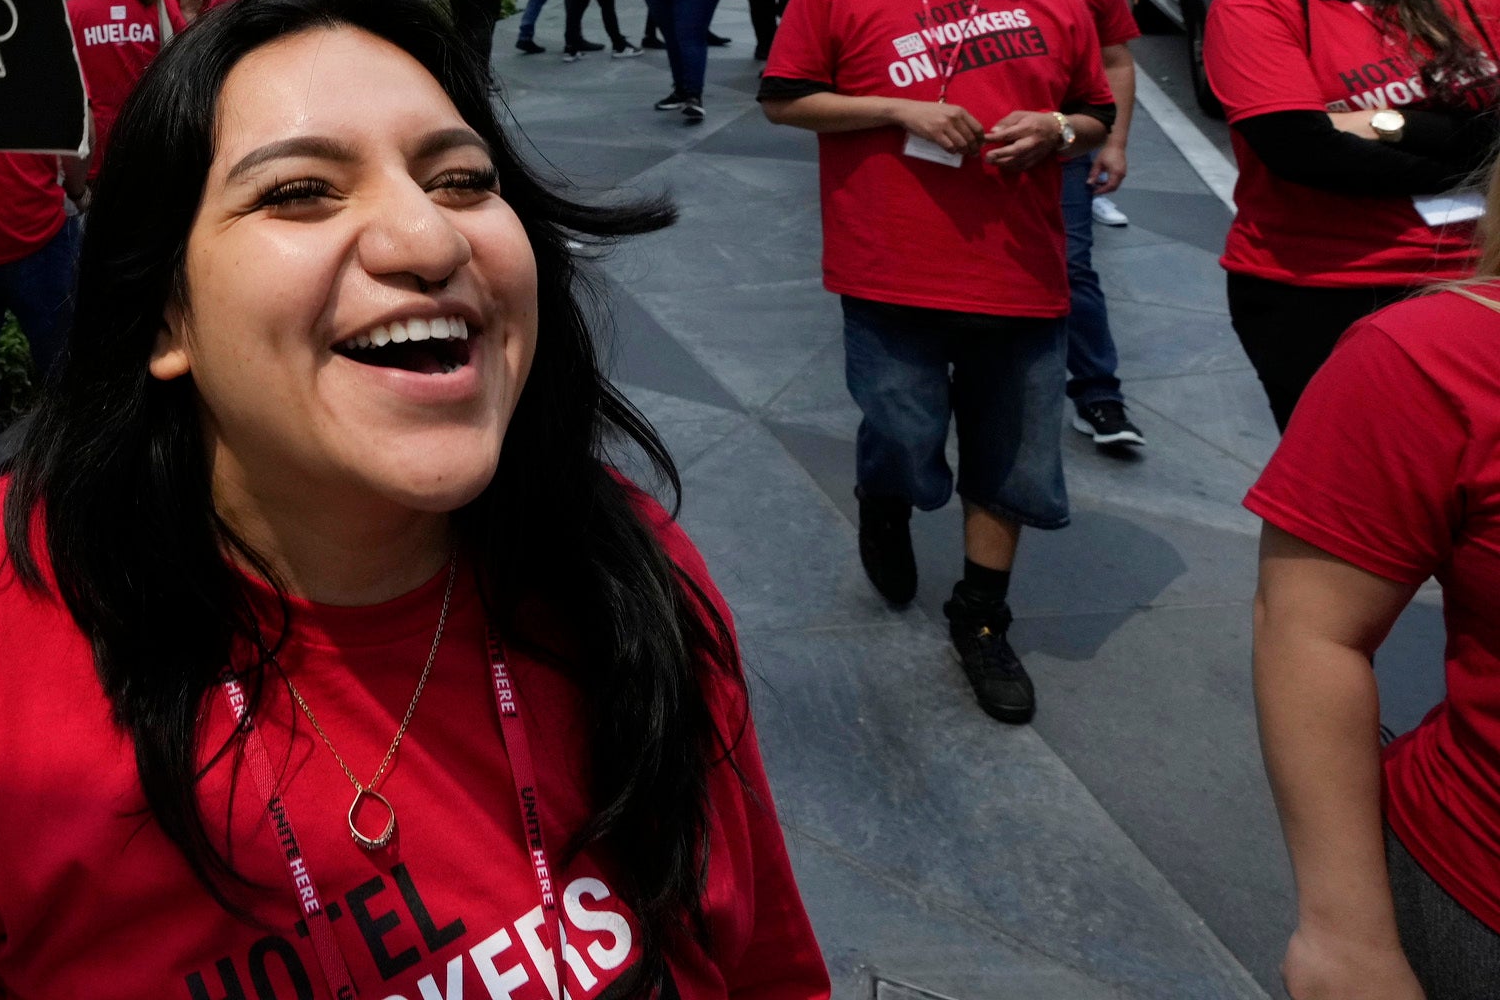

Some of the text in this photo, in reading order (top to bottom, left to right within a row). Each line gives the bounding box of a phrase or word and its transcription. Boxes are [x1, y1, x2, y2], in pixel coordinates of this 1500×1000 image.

[83, 22, 156, 47] HUELGA
[921, 8, 1032, 46] WORKERS
[888, 27, 1048, 88] ON STRIKE
[1339, 56, 1403, 92] HOT
[492, 663, 518, 719] HERE!
[268, 795, 323, 919] UNITE HERE!
[520, 786, 556, 911] UNITE HERE!
